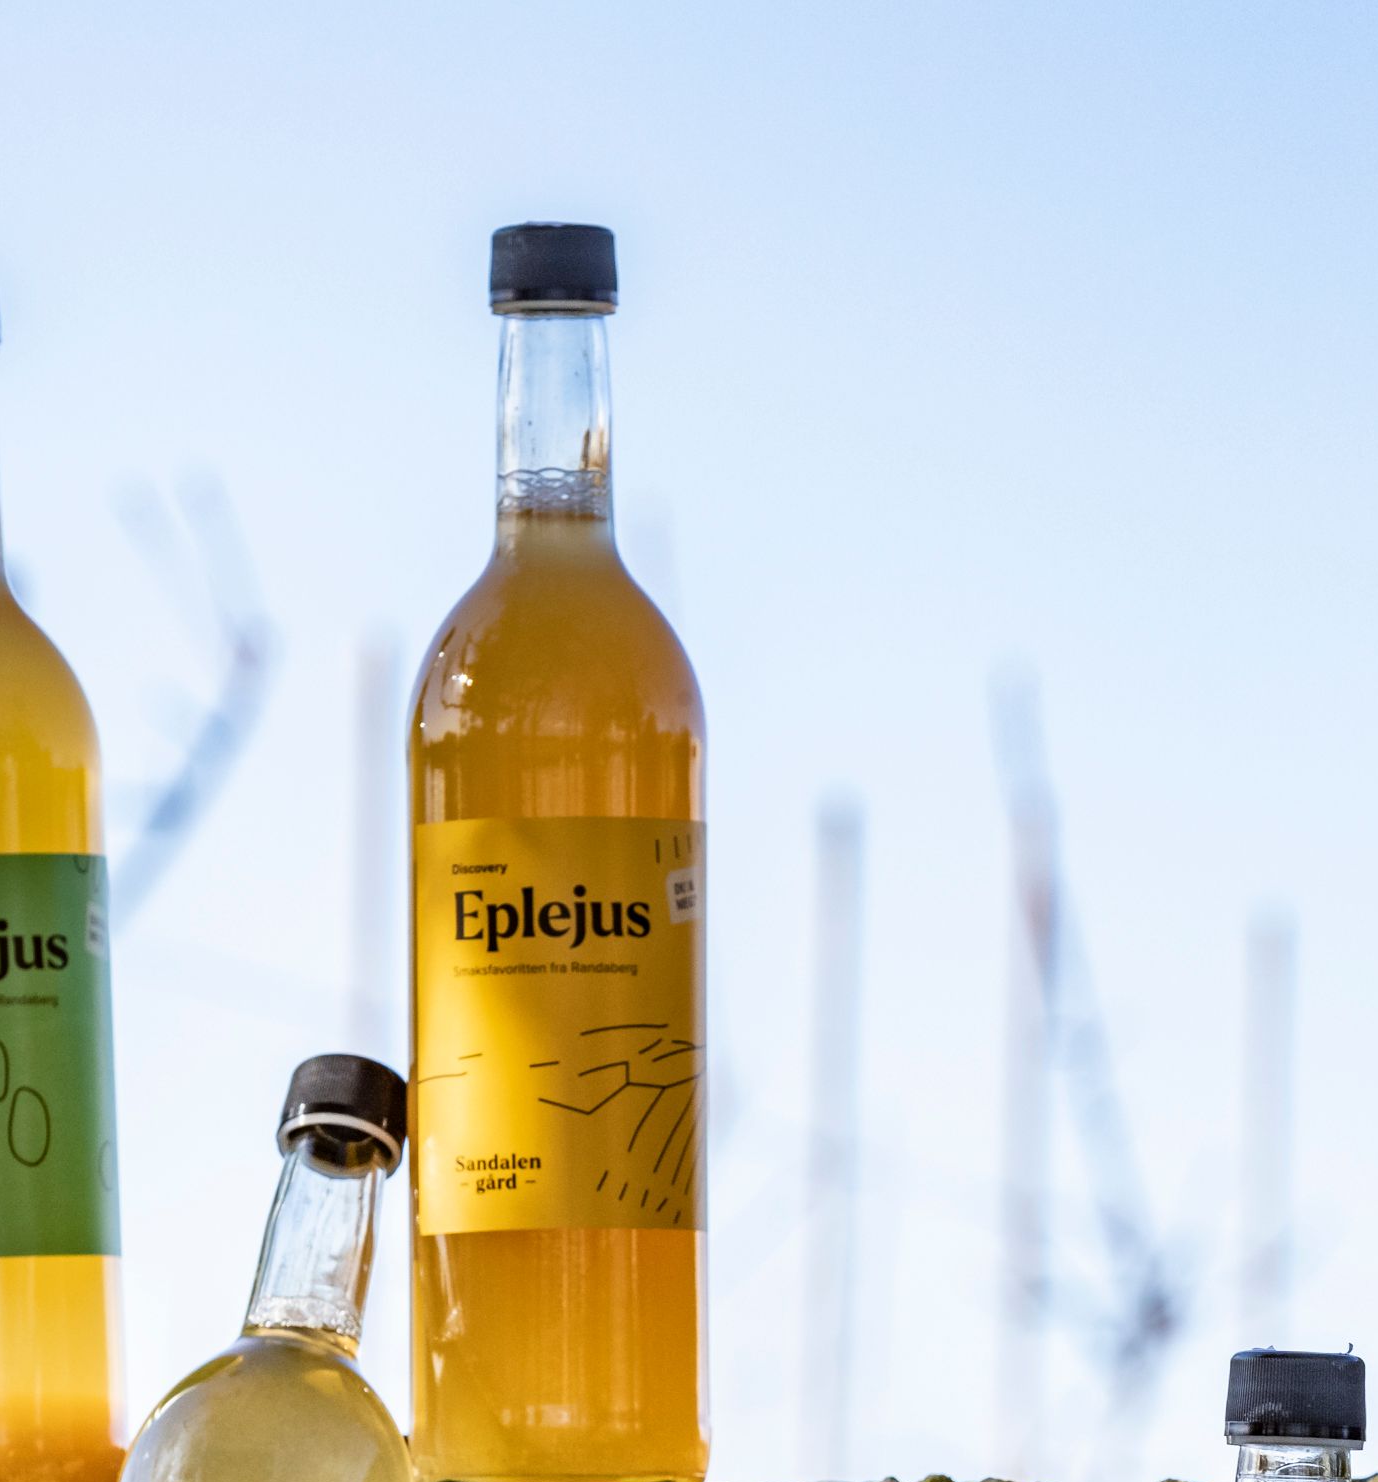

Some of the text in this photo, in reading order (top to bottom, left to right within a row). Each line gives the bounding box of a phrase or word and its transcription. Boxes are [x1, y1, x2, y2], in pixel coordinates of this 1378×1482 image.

[452, 863, 508, 875] Discovery
[454, 884, 651, 952] Eplejus
[452, 960, 638, 978] Smaksfavoritten fra Randaberg
[455, 1153, 542, 1173] Sandalen
[475, 1173, 518, 1194] gård
